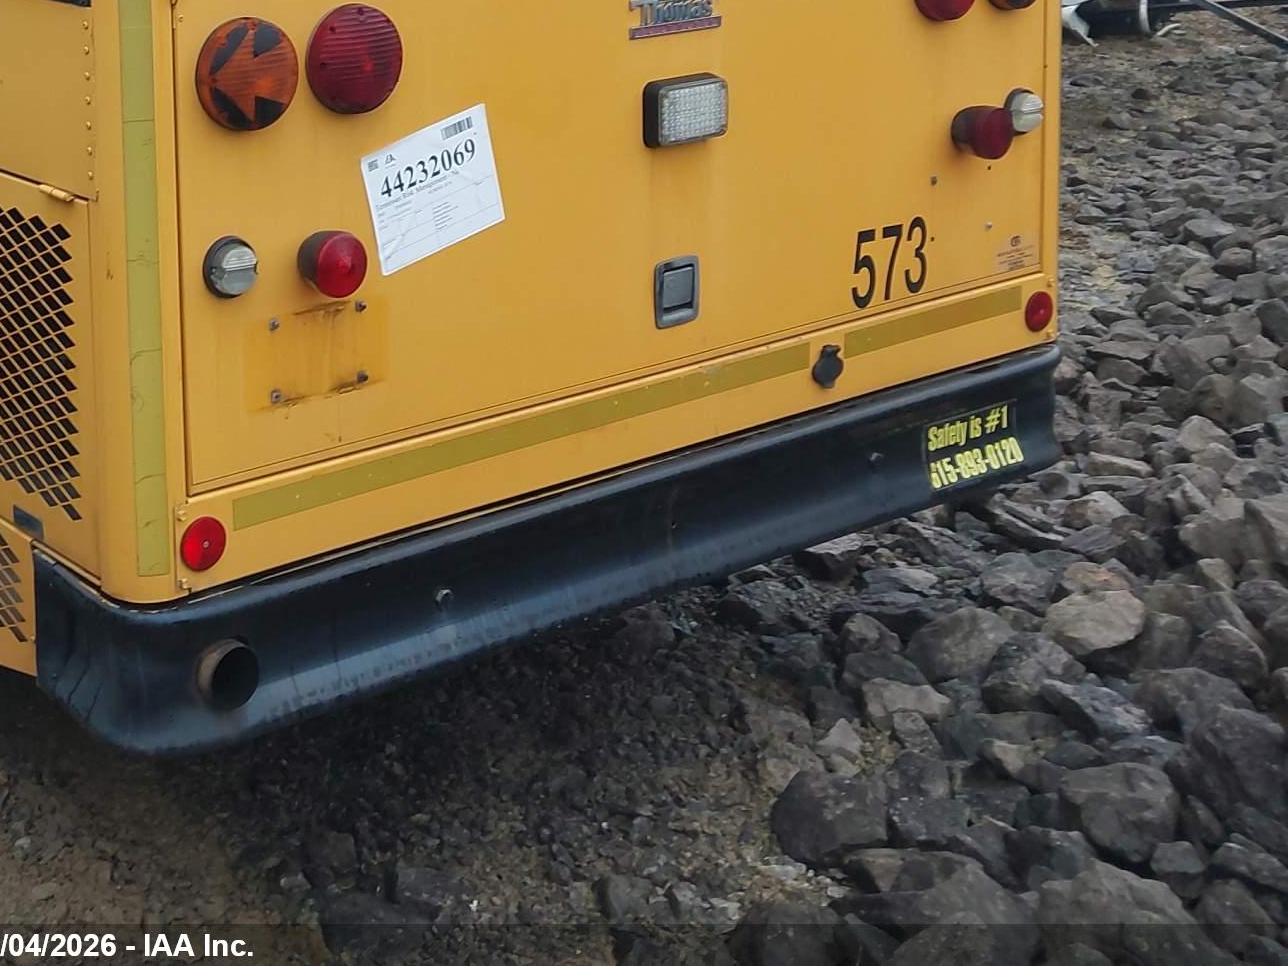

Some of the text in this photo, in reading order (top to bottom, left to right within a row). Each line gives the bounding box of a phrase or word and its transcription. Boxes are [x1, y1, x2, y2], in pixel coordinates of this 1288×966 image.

[381, 138, 475, 198] 44232069
[851, 216, 927, 308] 573
[927, 405, 1008, 451] Safety is #1
